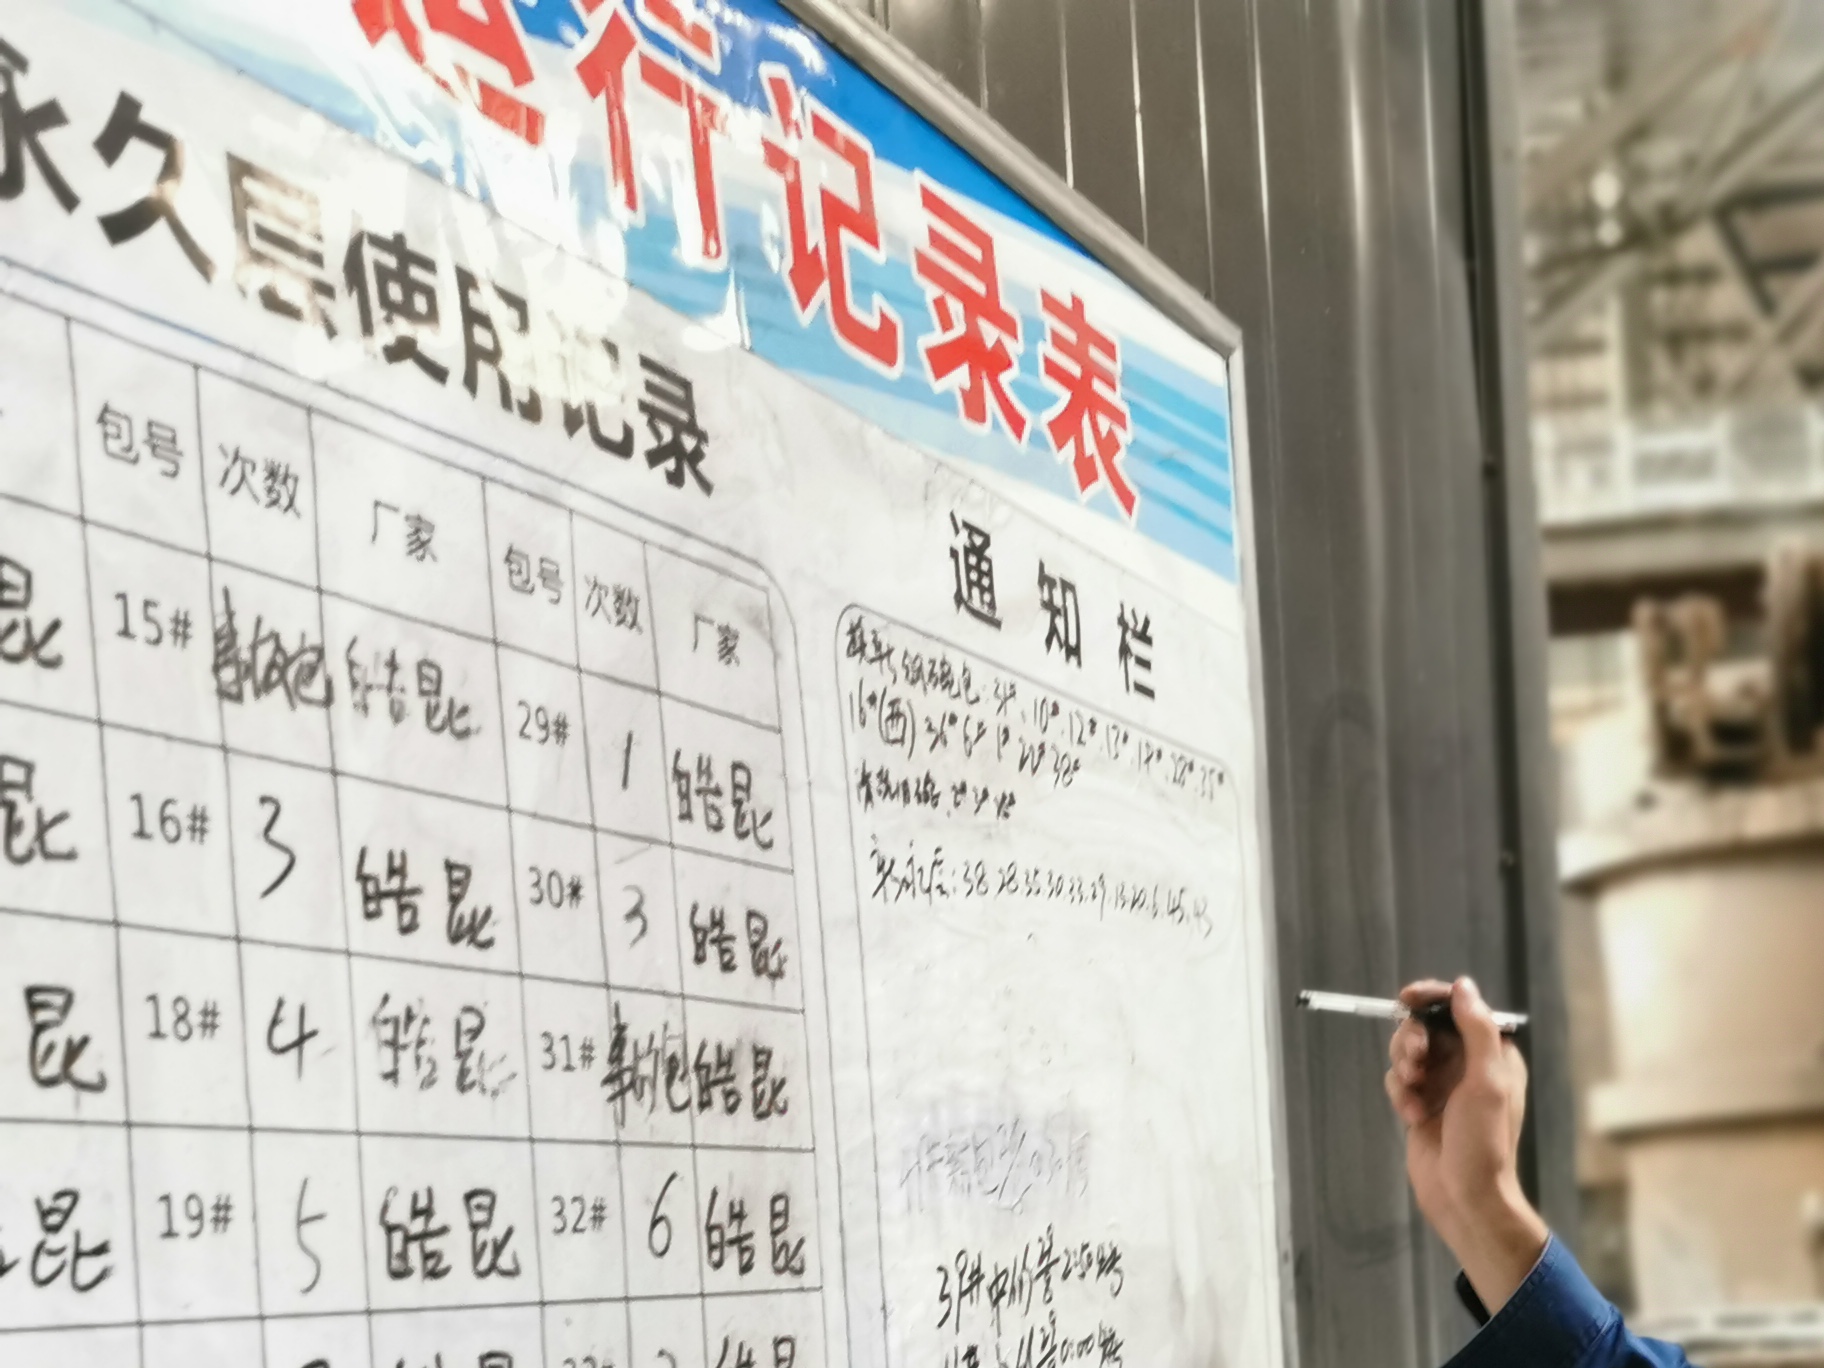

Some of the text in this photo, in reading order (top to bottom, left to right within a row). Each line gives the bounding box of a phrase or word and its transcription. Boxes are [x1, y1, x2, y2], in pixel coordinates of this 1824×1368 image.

[97, 401, 183, 479] 包号
[218, 443, 301, 518] 次数
[371, 499, 438, 563] 厂家
[503, 543, 565, 605] 包号
[584, 574, 643, 635] 次数
[950, 509, 1155, 700] 通知栏
[114, 592, 193, 649] 15#
[693, 612, 741, 667] 厂家
[517, 699, 570, 747] 29#
[621, 730, 634, 791] 1
[129, 793, 211, 845] 16#
[259, 794, 297, 900] 3
[527, 865, 584, 910] 30#
[622, 884, 648, 949] 3
[145, 993, 221, 1042] 18#
[266, 996, 320, 1079] 4
[539, 1030, 597, 1072] 31#
[156, 1192, 234, 1239] 19#
[298, 1178, 327, 1295] 5
[551, 1194, 609, 1234] 32#
[647, 1172, 679, 1258] 6
